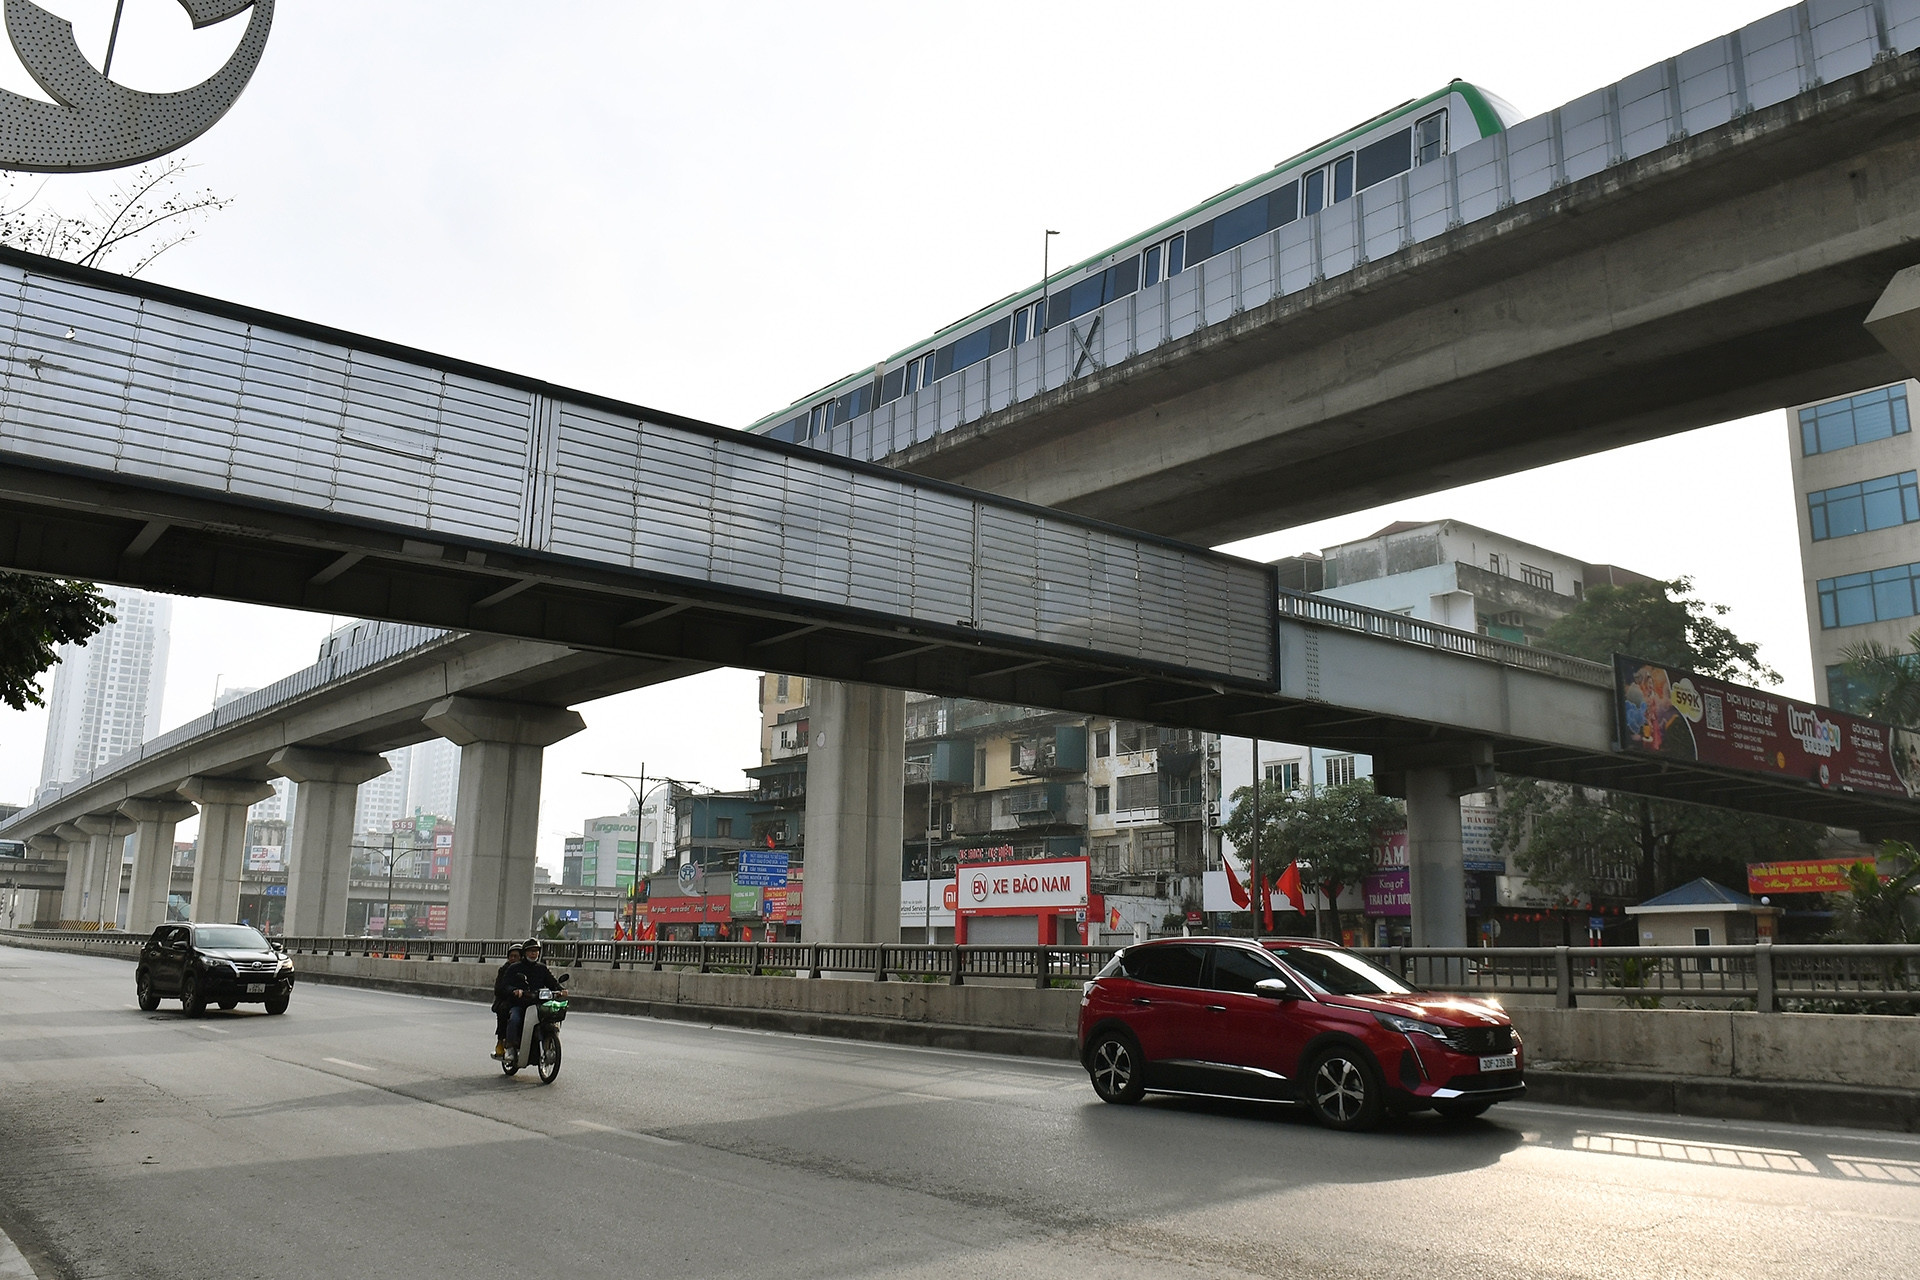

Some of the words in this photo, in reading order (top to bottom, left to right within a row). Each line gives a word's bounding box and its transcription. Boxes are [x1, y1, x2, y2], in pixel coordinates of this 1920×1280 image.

[1675, 690, 1700, 709] 599K
[1735, 709, 1751, 722] THEO
[1803, 739, 1831, 755] STUDIO
[393, 821, 414, 829] 369
[973, 880, 988, 895] BN
[992, 879, 1009, 895] XE
[1042, 875, 1071, 893] NAM
[1380, 879, 1394, 891] King
[1394, 878, 1404, 888] of
[1369, 892, 1383, 906] TRÁI
